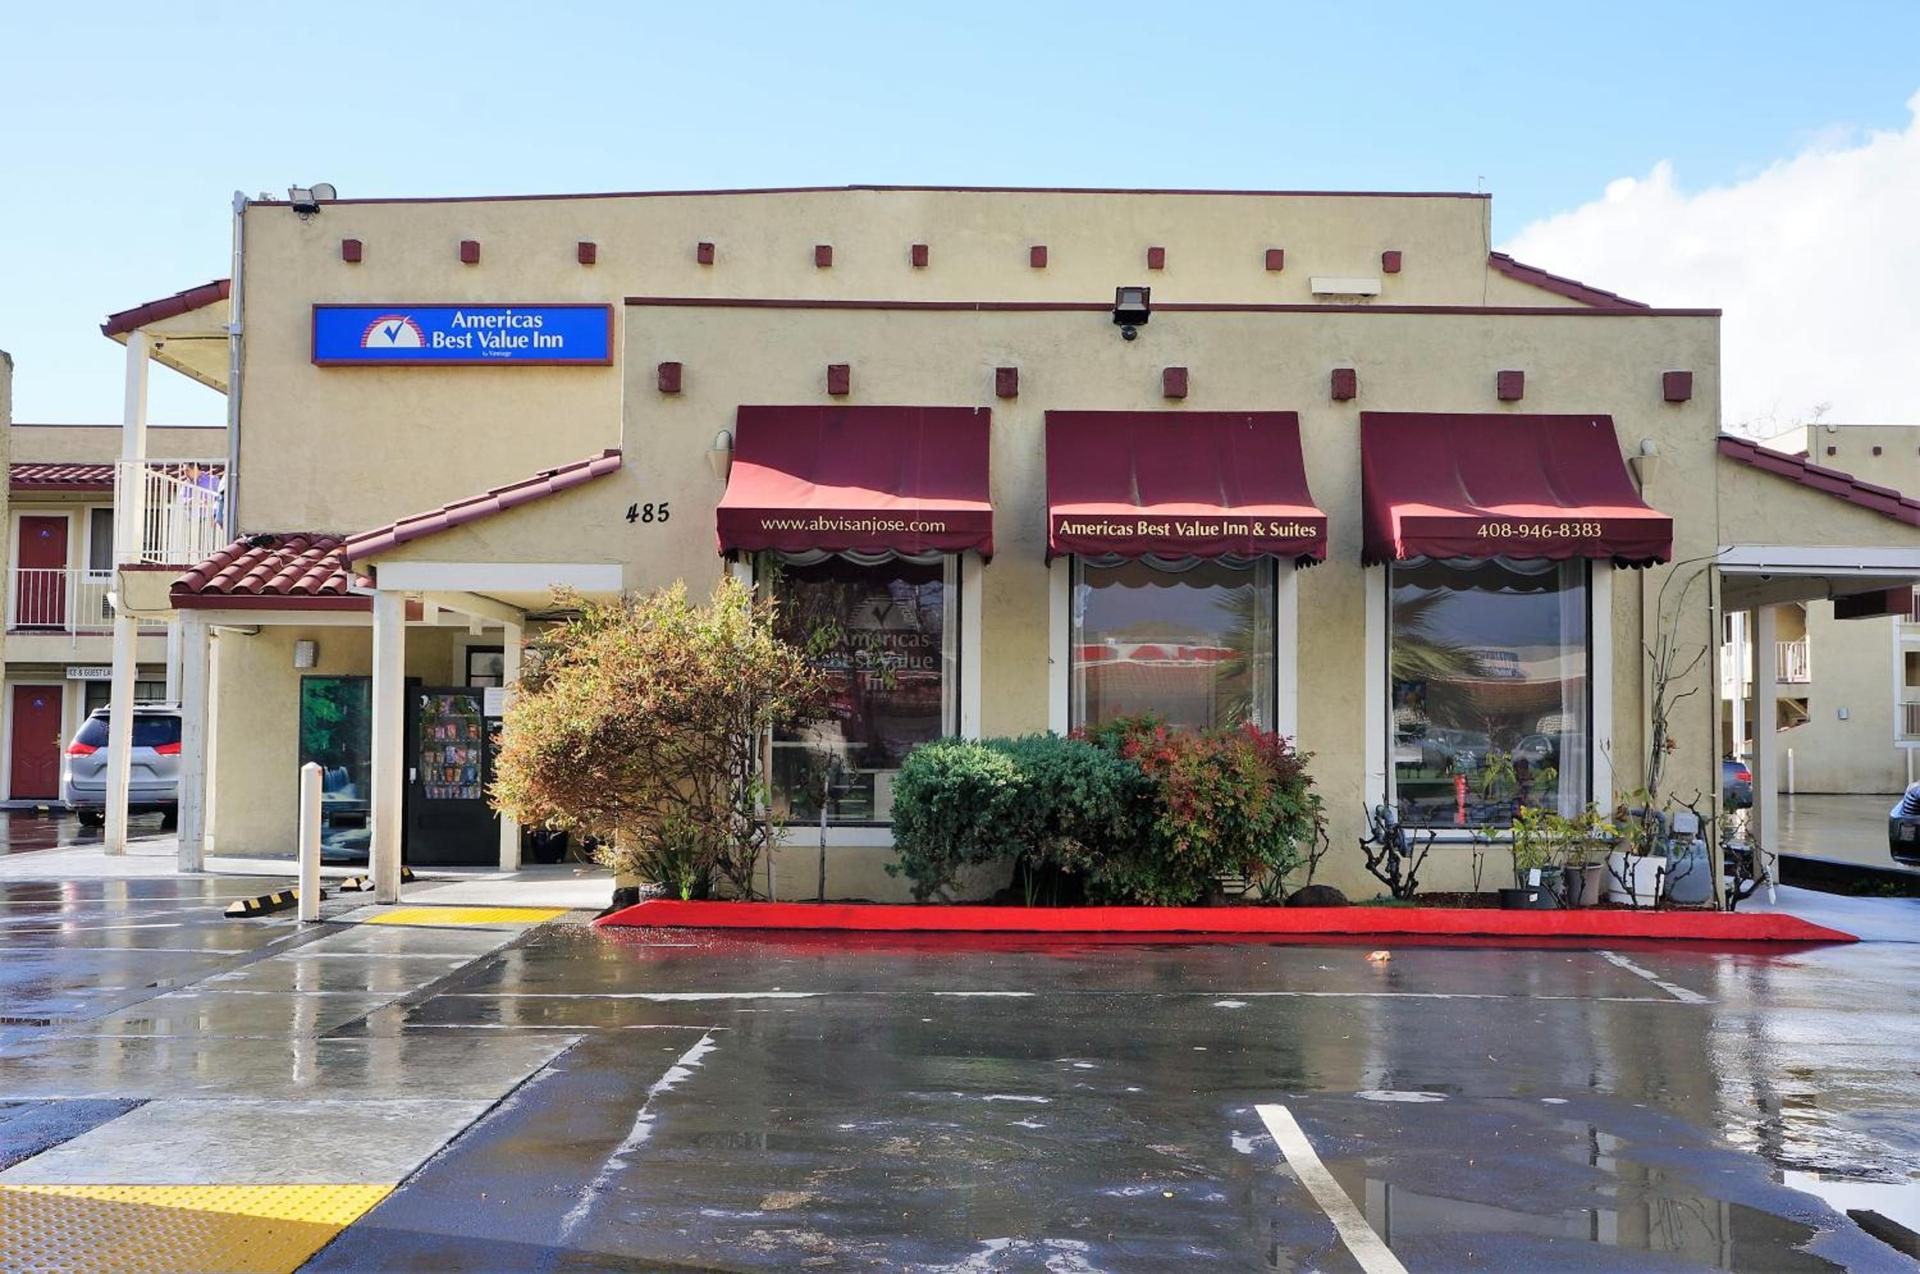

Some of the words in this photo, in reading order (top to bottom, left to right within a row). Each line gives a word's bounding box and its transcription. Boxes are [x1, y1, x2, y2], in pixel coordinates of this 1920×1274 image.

[451, 309, 543, 328] Americas
[432, 331, 472, 348] Best
[477, 330, 529, 348] Value
[533, 331, 564, 348] Inn
[625, 502, 671, 523] 485
[760, 514, 946, 536] www.abvisanjose.com
[1059, 520, 1134, 536] Americas
[1137, 521, 1171, 536] Best
[1175, 521, 1220, 537] Value
[1223, 521, 1249, 536] Inn
[1252, 522, 1266, 536] &
[1269, 521, 1317, 537] Suites
[1477, 523, 1602, 538] 408-946-8383
